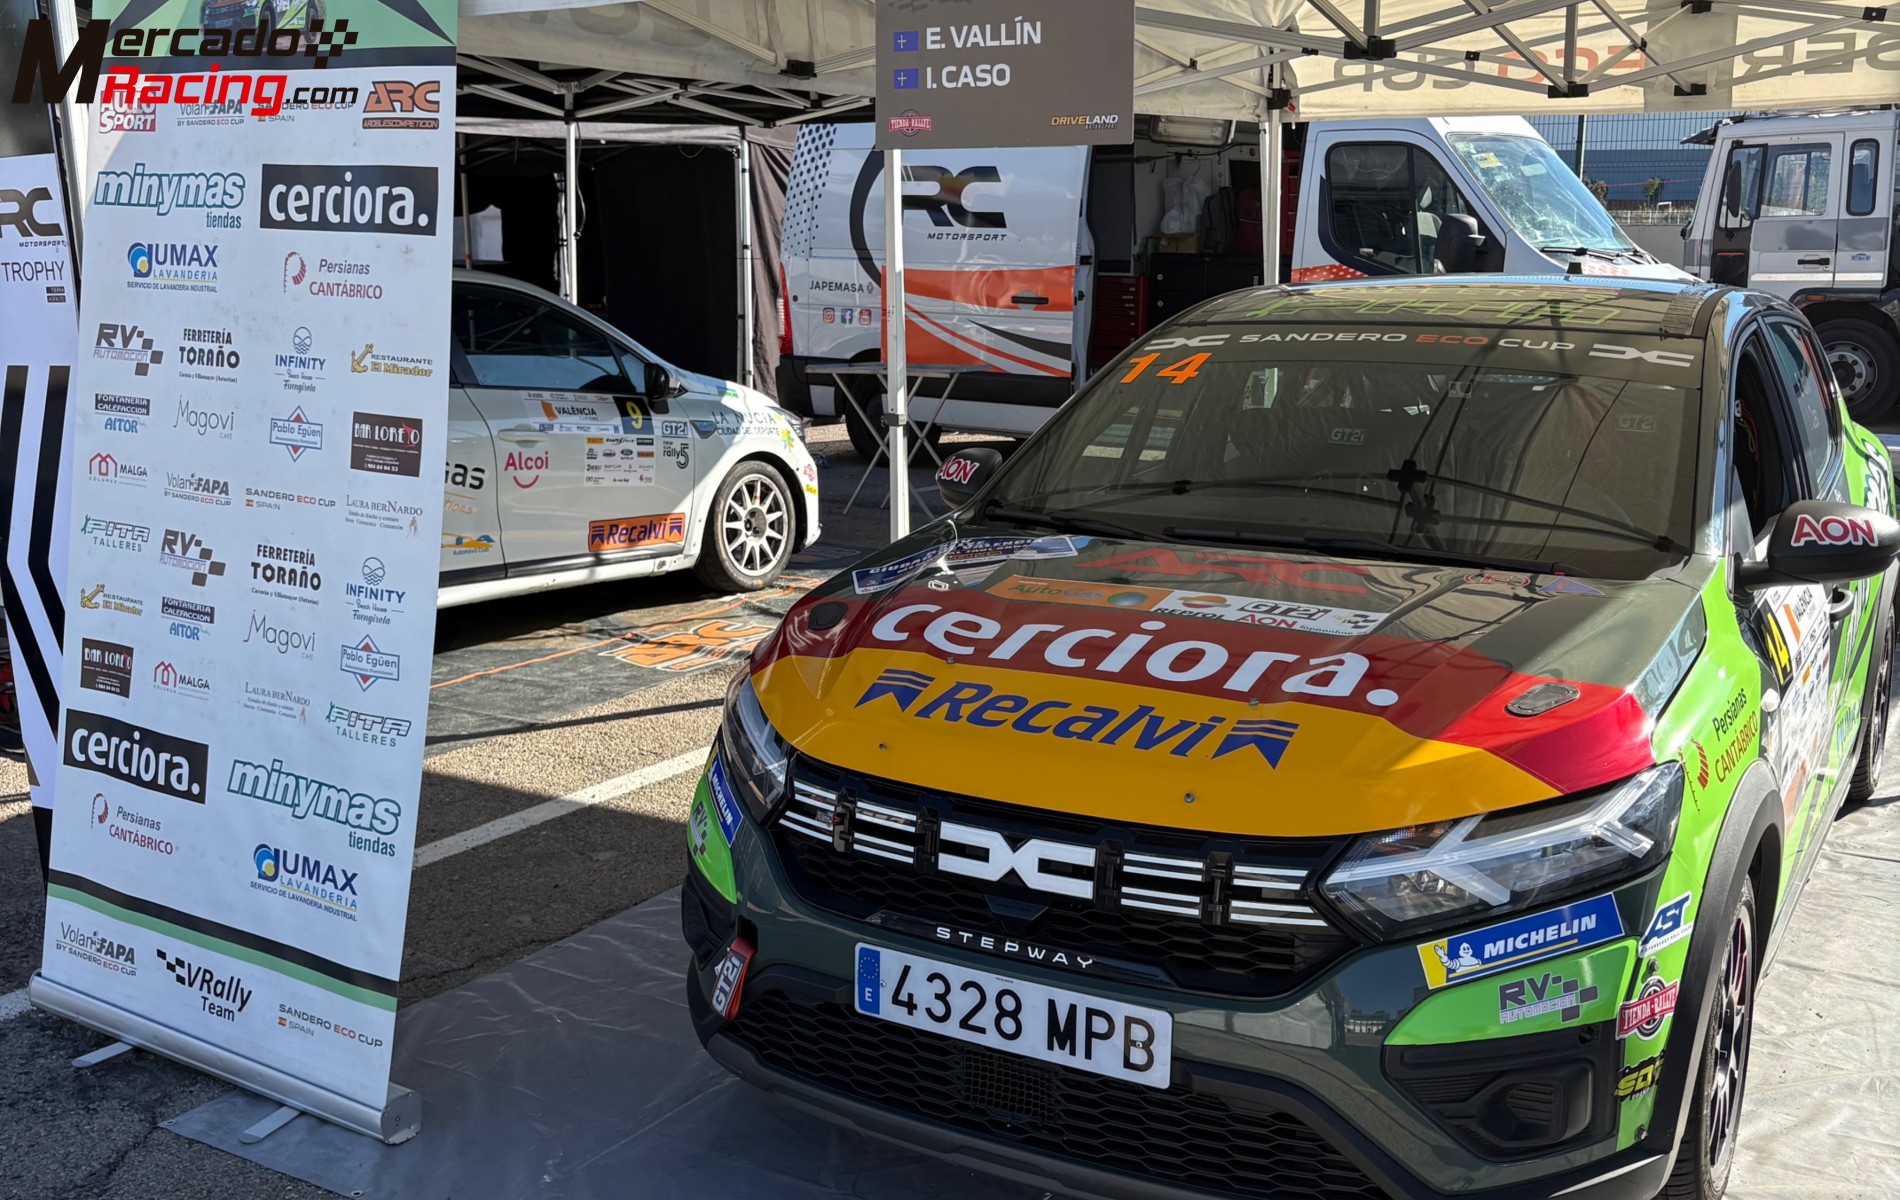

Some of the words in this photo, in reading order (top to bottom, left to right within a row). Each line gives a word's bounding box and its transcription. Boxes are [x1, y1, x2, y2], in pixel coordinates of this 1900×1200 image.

[926, 27, 945, 50] E.
[950, 16, 1042, 48] VALLÍN
[926, 67, 937, 89] I.
[942, 64, 1011, 87] CASO
[363, 81, 440, 113] ARC
[99, 111, 155, 134] SPORT
[217, 118, 229, 126] ECO
[230, 118, 245, 126] CUP
[1052, 114, 1119, 127] DRIVELAND
[94, 163, 246, 216] minymas
[268, 171, 429, 227] cerciora.
[206, 211, 242, 230] tiendas
[19, 240, 65, 248] MOTORSPORT
[927, 232, 1008, 242] MOTORSPORT
[0, 260, 65, 282] TROPHY
[319, 259, 370, 276] Persianas
[127, 281, 152, 291] SERVICIO
[189, 284, 218, 293] INDUSTRIAL
[310, 280, 383, 299] CANTÁBRICO
[810, 281, 864, 294] JAPEMASA
[97, 323, 138, 349] RV
[183, 328, 233, 345] FERRETERÍA
[1239, 331, 1408, 344] SANDERO
[1415, 332, 1490, 346] ECO
[1497, 338, 1576, 352] CUP
[179, 345, 240, 369] TORAÑO
[275, 354, 326, 371] INFINITY
[371, 354, 433, 366] RESTAURANTE
[1120, 352, 1213, 385] 14
[383, 363, 433, 377] Mirador
[97, 402, 148, 416] CALEFACCION
[172, 394, 234, 437] Magovi
[555, 405, 598, 417] VALÈNCIA
[626, 401, 643, 430] 9
[104, 416, 139, 434] AITOR
[273, 421, 296, 434] Pablo
[297, 425, 321, 438] Egüen
[354, 422, 372, 440] BAR
[375, 421, 420, 446] LORETO
[662, 420, 689, 436] GT2i
[119, 463, 148, 478] MALGA
[504, 451, 549, 472] Alcoi
[936, 456, 980, 484] AON
[171, 492, 200, 503] SANDERO
[200, 497, 214, 505] ECO
[245, 488, 295, 502] SANDERO
[296, 494, 317, 506] ECO
[318, 498, 336, 509] CUP
[257, 501, 281, 511] SPAIN
[346, 494, 370, 509] LAURA
[607, 519, 668, 545] Recalvi
[1793, 515, 1876, 546] AON
[93, 536, 143, 553] TALLERES
[162, 528, 198, 557] RV
[257, 544, 316, 567] FERRETERÍA
[251, 561, 322, 591] TORAÑO
[102, 593, 144, 605] RESTAURANTE
[346, 583, 406, 604] INFINITY
[1008, 583, 1105, 600] AutoGas
[163, 606, 211, 622] CALEFACCION
[352, 609, 391, 625] Fuengirola
[1236, 613, 1299, 629] AON
[1239, 600, 1333, 620] GT2i
[169, 621, 200, 641] AITOR
[243, 609, 316, 654] Magovi
[84, 647, 102, 662] BAR
[343, 648, 364, 663] Pablo
[366, 654, 397, 669] Egüen
[871, 603, 1399, 708] cerciora.
[1761, 612, 1790, 686] 14
[178, 674, 210, 690] MALGA
[245, 682, 271, 698] LAURA
[916, 681, 1227, 759] Recalvi
[1712, 687, 1748, 742] Persianas
[336, 725, 397, 748] TALLERES
[1715, 710, 1758, 784] CANTÁBRICO
[71, 730, 200, 795] cerciora.
[227, 758, 401, 836] minymas
[712, 773, 734, 826] MICHELIN
[116, 805, 161, 831] Persianas
[109, 823, 174, 855] CANTÁBRICO
[348, 831, 396, 857] tiendas
[250, 881, 278, 897] SERVICIO
[279, 888, 287, 898] DE
[324, 900, 358, 922] INDUSTRIAL
[1641, 894, 1691, 945] AST
[936, 926, 1094, 969] STEPWAY
[1483, 914, 1597, 959] MICHELIN
[56, 943, 67, 951] BY
[68, 948, 102, 966] SANDERO
[103, 961, 119, 972] ECO
[120, 967, 137, 977] CUP
[186, 962, 253, 1012] VRally
[711, 955, 742, 1014] GT2i
[864, 987, 873, 1003] E
[1499, 973, 1551, 1010] RV
[201, 996, 236, 1022] Team
[891, 964, 1024, 1042] 4328
[1047, 998, 1156, 1074] MPB
[279, 1003, 332, 1030] SANDERO
[333, 1024, 356, 1040] ECO
[358, 1033, 383, 1048] CUP
[288, 1021, 315, 1036] SPAIN
